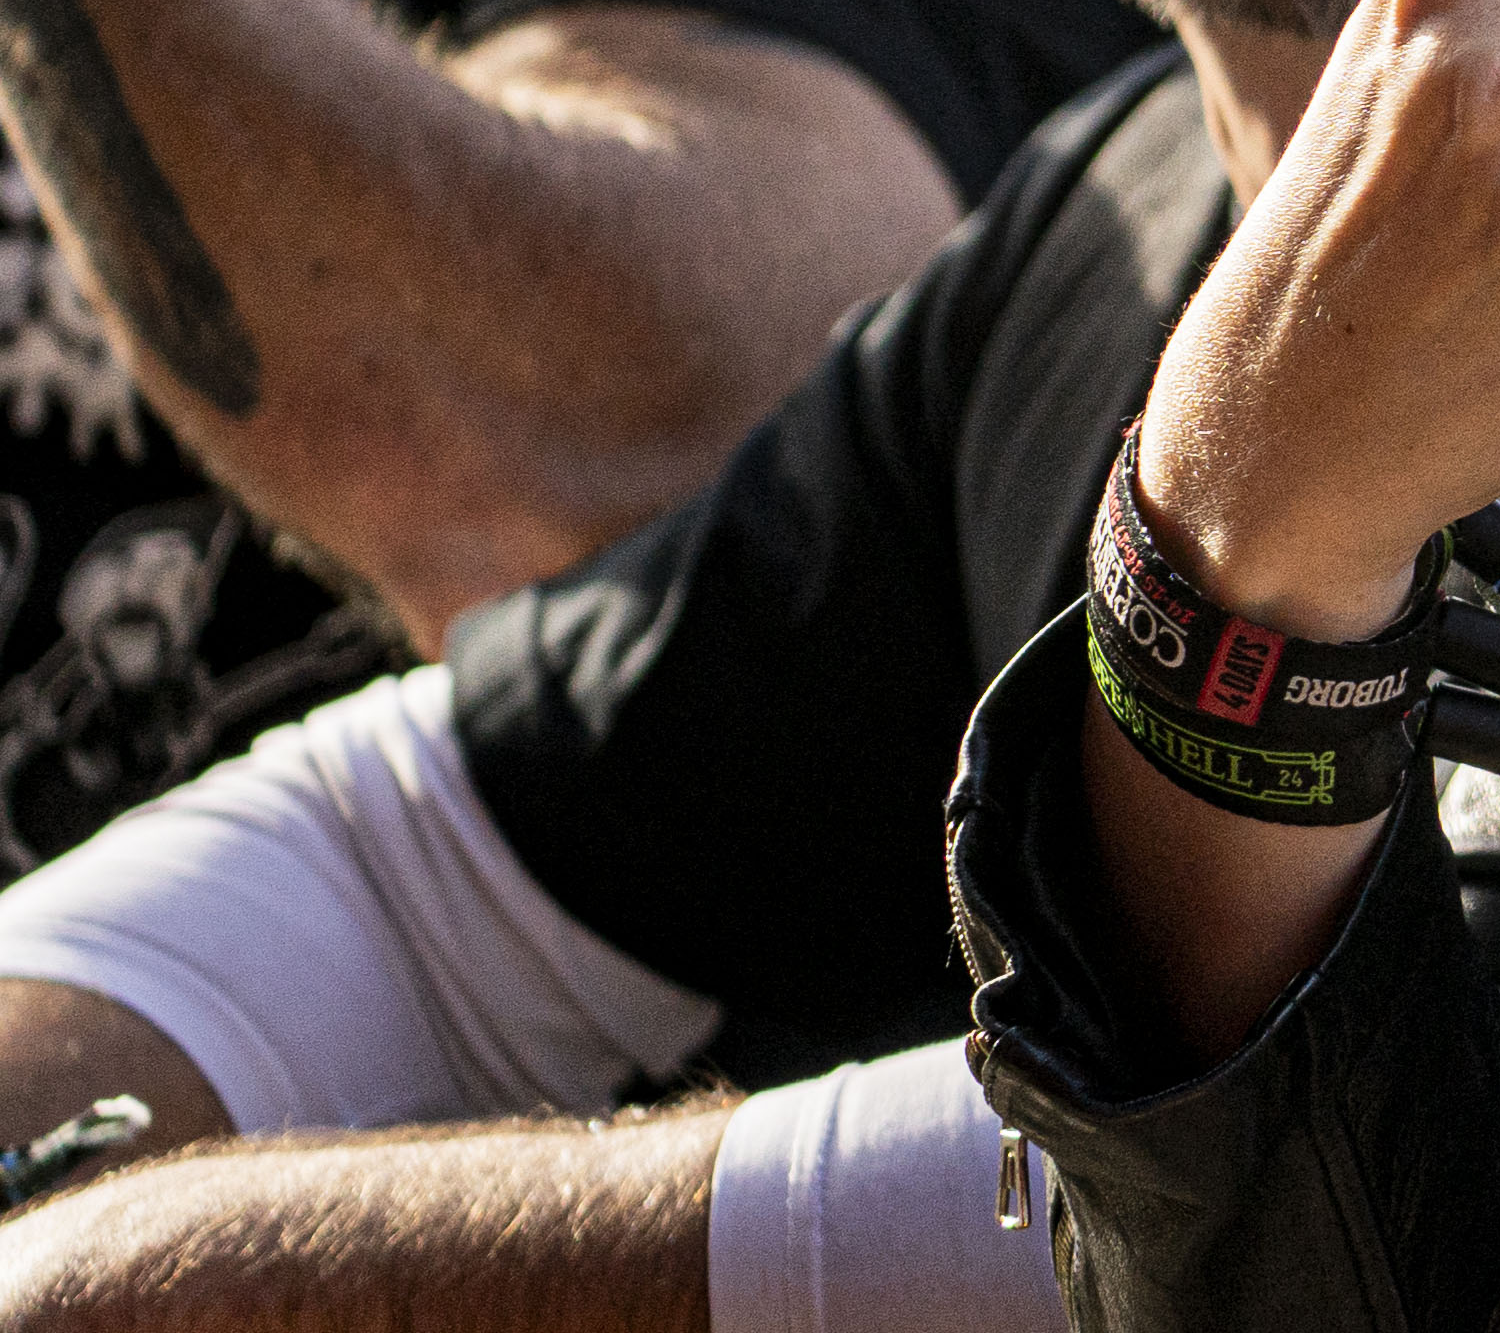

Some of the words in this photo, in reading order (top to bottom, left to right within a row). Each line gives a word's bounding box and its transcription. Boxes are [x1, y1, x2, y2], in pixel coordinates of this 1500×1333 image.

[1218, 633, 1270, 694] DAYS
[1284, 667, 1409, 707] TUBORG
[1279, 769, 1303, 789] 24
